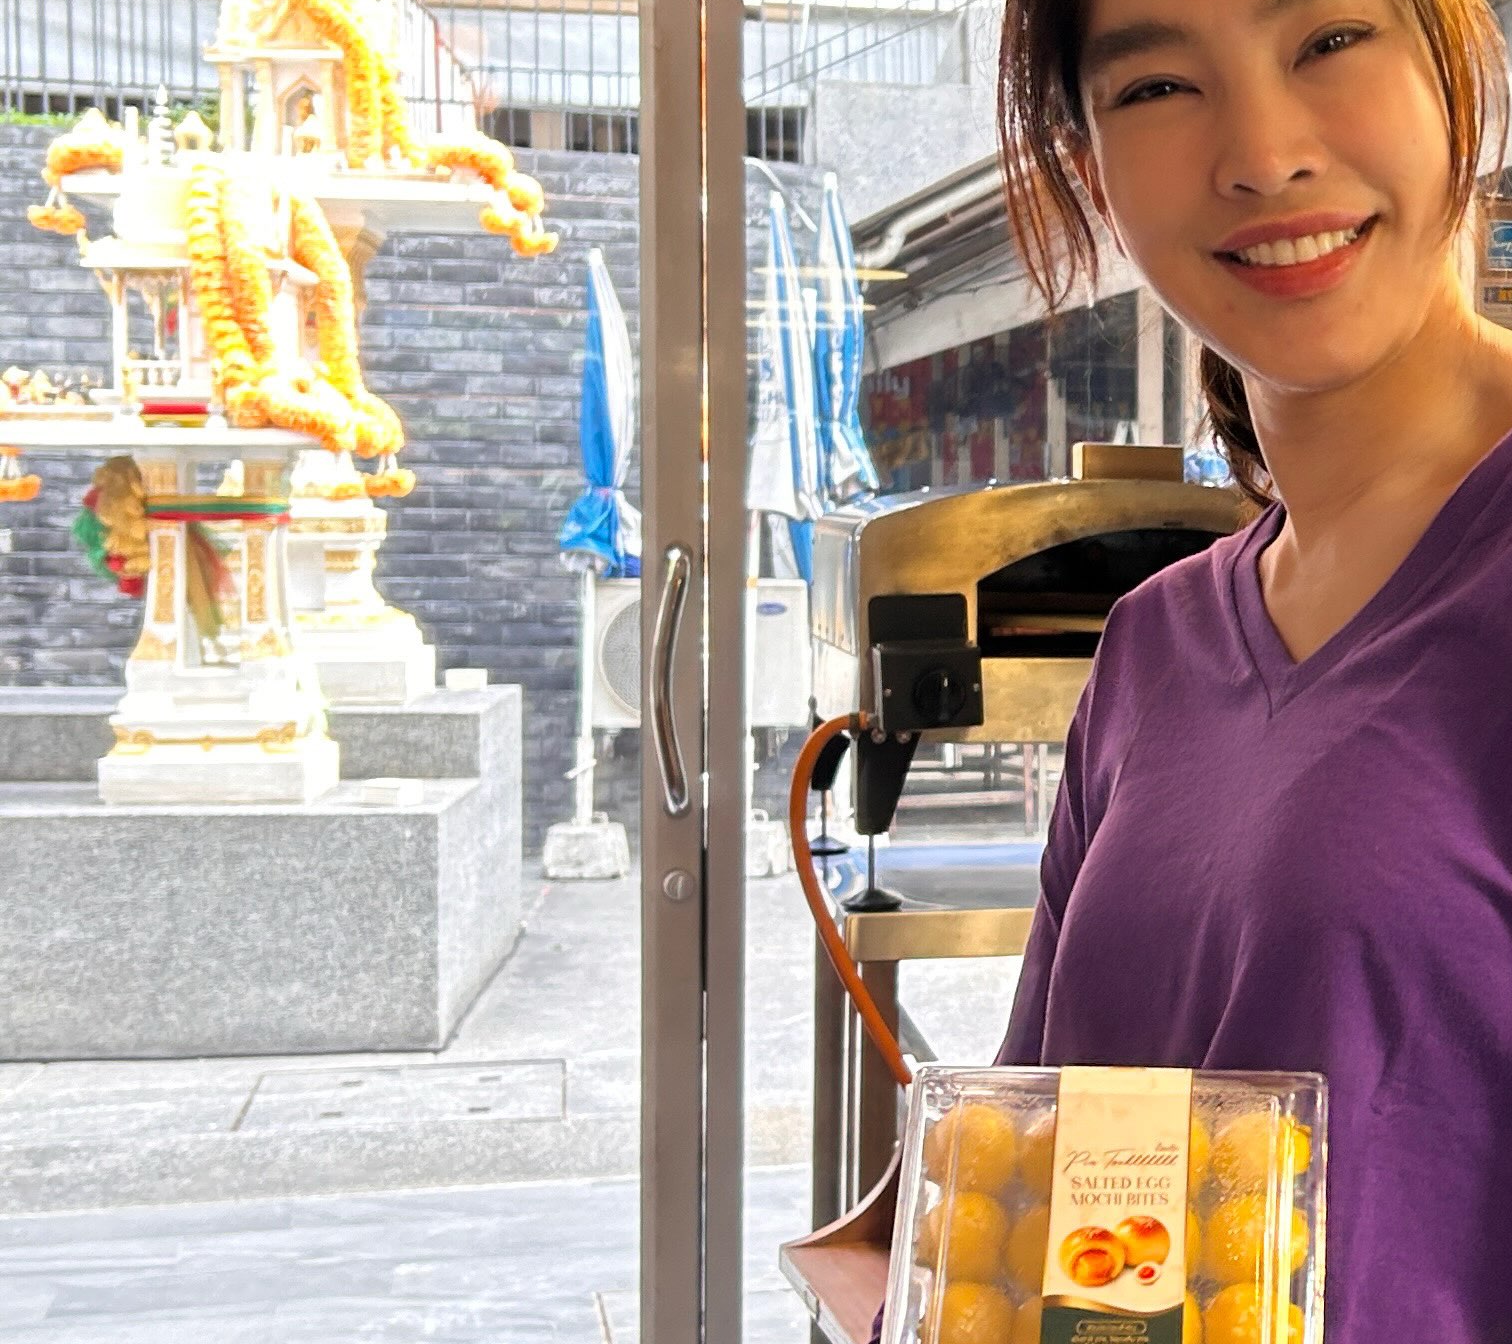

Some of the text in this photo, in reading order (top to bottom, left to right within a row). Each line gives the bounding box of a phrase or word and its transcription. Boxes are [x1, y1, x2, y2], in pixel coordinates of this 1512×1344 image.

[1071, 1176, 1170, 1189] SALTED EGG
[1070, 1193, 1169, 1205] MOCHI BITES
